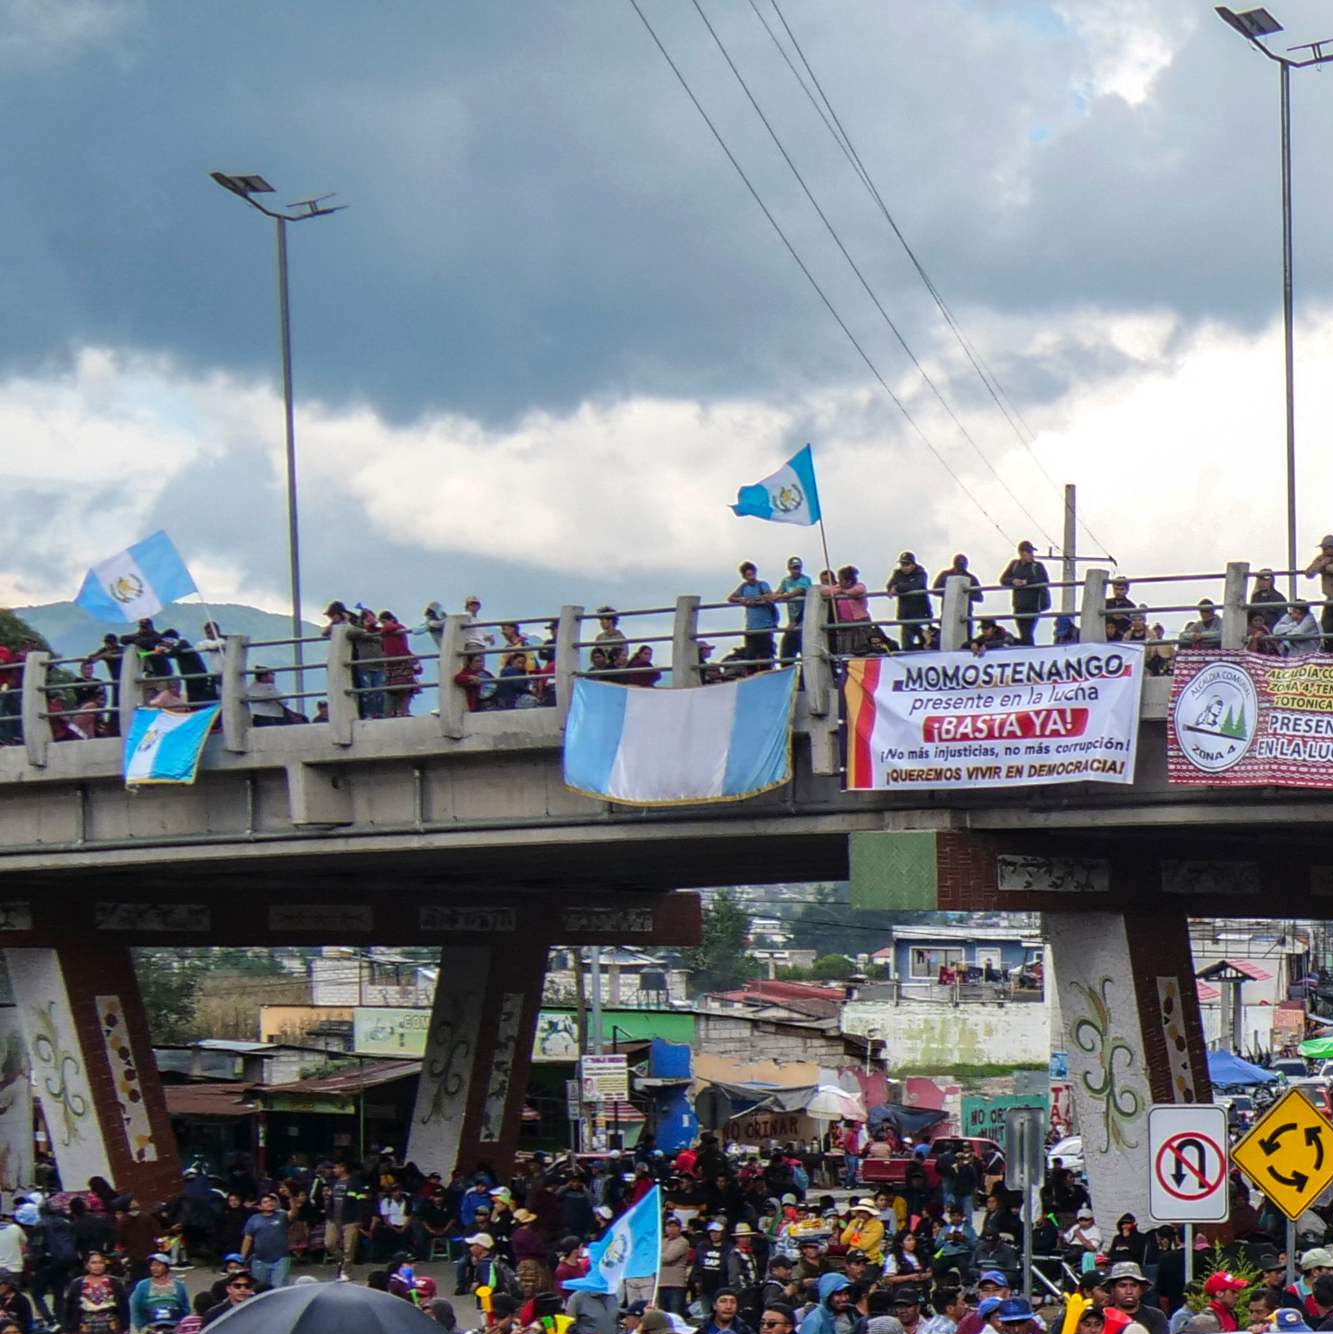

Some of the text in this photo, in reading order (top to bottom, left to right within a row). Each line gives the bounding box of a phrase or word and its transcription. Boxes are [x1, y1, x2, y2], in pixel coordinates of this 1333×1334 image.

[904, 654, 1124, 691] MOMOSTENANGO
[1269, 681, 1299, 692] ZONA
[910, 685, 1099, 715] presente en la lucha
[933, 709, 1073, 743] ¡BASTA YA!
[880, 737, 1131, 763] ¡No más injusticias, no más corrupción!
[1192, 744, 1236, 760] ZONA 4
[1258, 740, 1275, 756] EN
[1280, 742, 1301, 758] LA
[886, 758, 1125, 785] ¡QUEREMOS VIVIR EN DEMOCRACIA!
[721, 1115, 799, 1139] NO ORINAR
